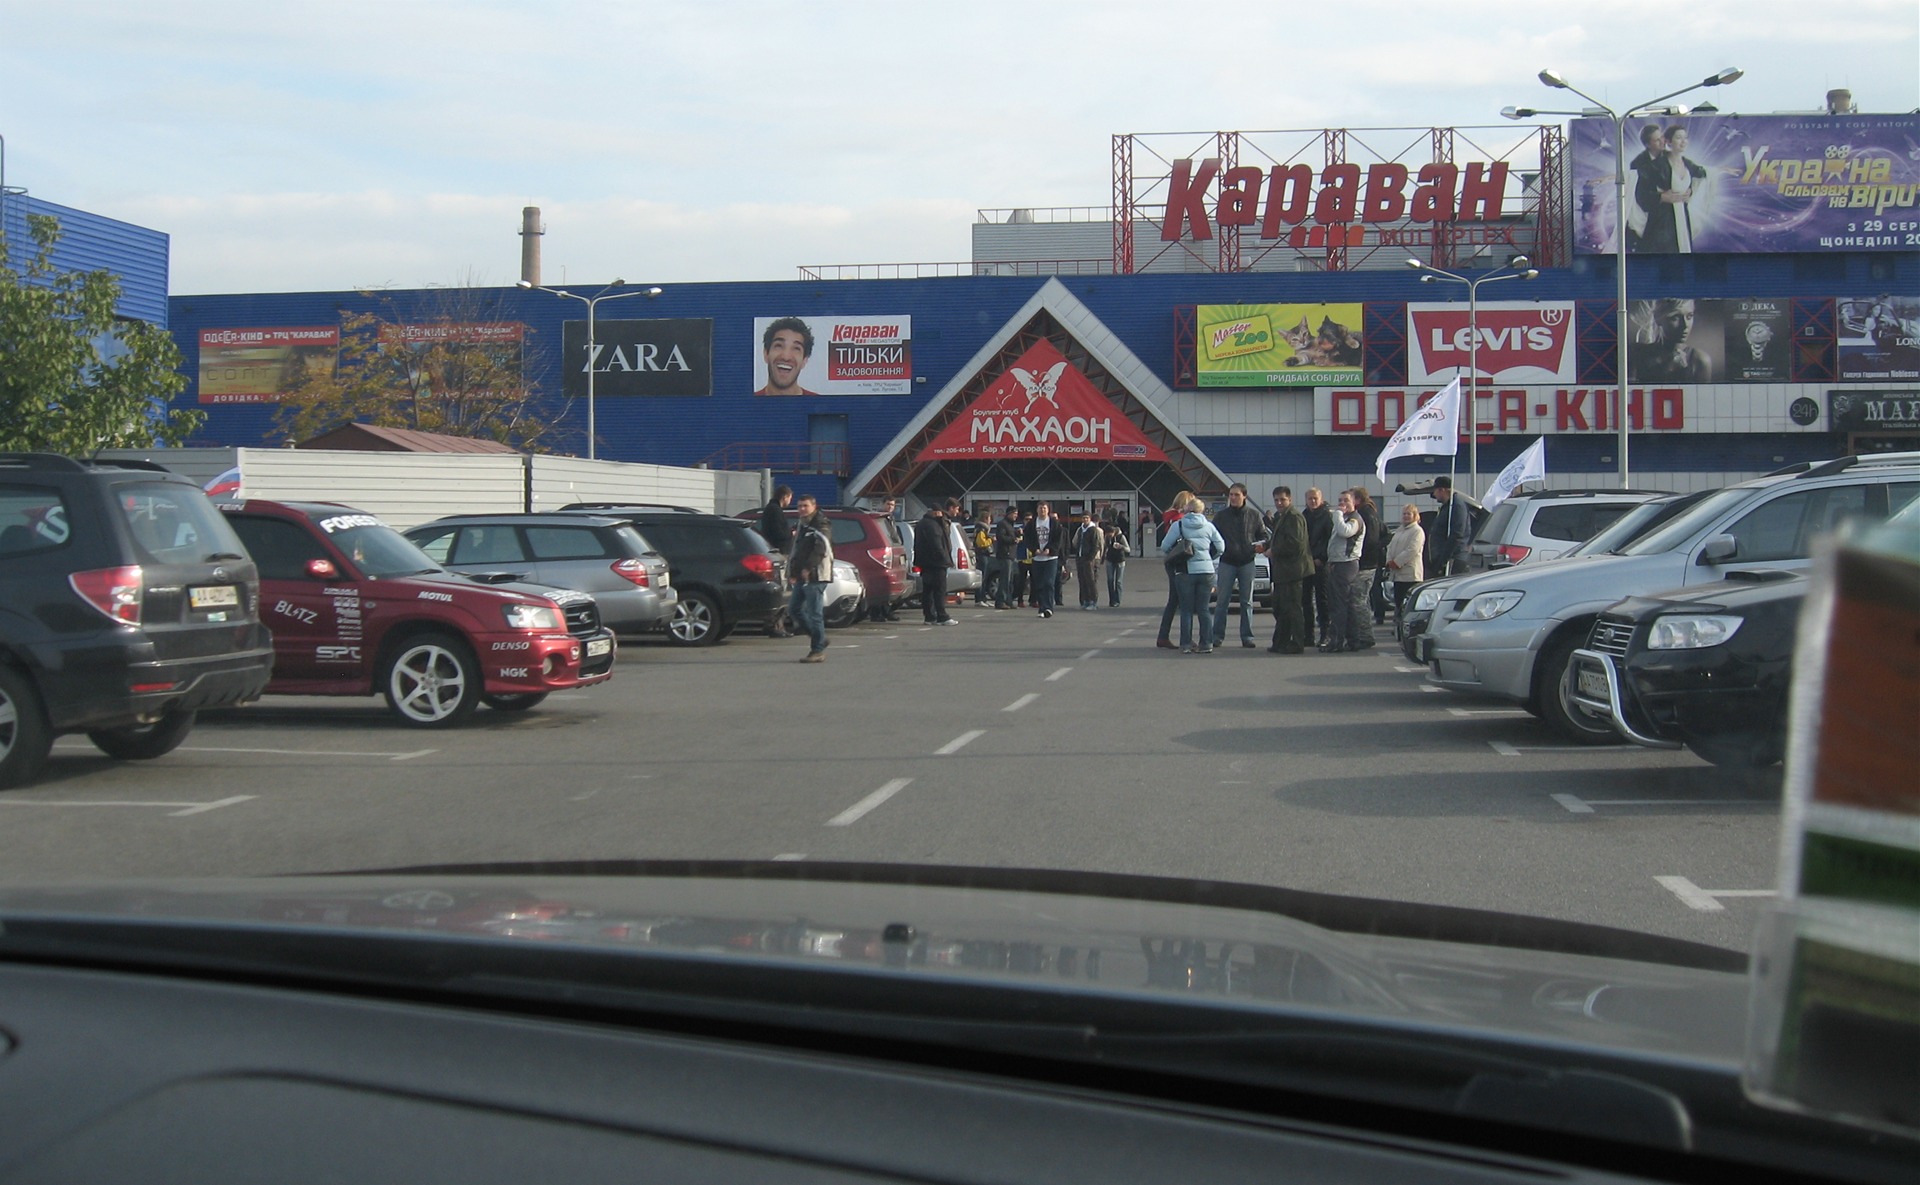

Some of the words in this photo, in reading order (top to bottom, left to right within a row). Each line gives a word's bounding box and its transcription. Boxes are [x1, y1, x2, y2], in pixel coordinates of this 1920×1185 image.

[1161, 158, 1509, 241] Караван
[1863, 221, 1883, 232] 29
[1889, 222, 1920, 231] СЕР
[1820, 236, 1898, 248] ЩОНЕДІЛІ
[1752, 303, 1776, 311] ДЕКА
[273, 332, 290, 340] ТРЦ
[832, 325, 899, 341] Караван
[582, 344, 692, 372] ZARA
[836, 348, 903, 364] ТІЛЬКИ
[837, 367, 904, 376] ЗАДОВОЛЕННЯ!
[1266, 373, 1309, 383] ПРИДБАЙ
[1311, 374, 1332, 382] СОБІ
[1333, 374, 1360, 384] ДРУГА
[213, 394, 263, 402] ДОВІДКА:
[1002, 408, 1019, 416] клуб
[1792, 403, 1818, 418] 24h
[970, 416, 1111, 444] МАХАОН
[983, 446, 997, 454] Бар
[1009, 445, 1045, 454] Ресторан
[1056, 445, 1098, 454] Дискотека
[417, 591, 453, 602] MOTUL
[274, 600, 318, 625] BLITZ
[492, 642, 530, 651] DENSO
[500, 668, 528, 678] NGK
